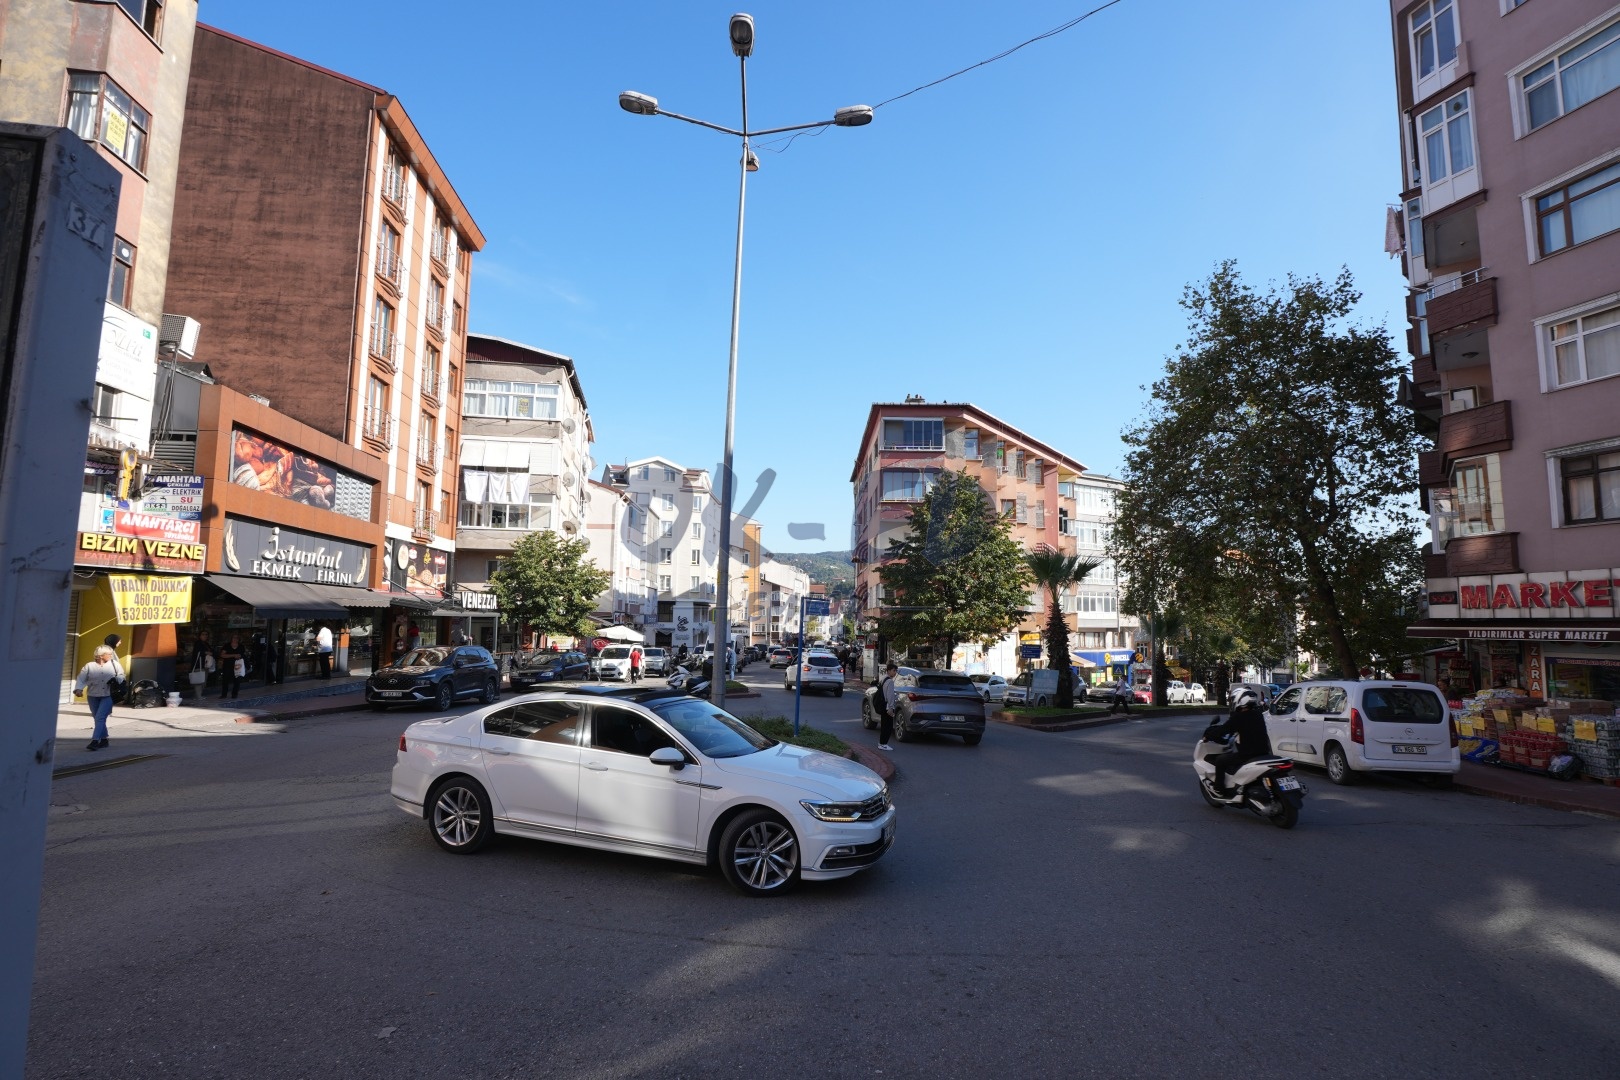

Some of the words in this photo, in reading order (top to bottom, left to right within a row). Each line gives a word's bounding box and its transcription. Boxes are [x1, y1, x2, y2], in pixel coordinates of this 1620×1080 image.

[155, 475, 202, 484] ANAHTAR
[172, 488, 202, 496] ELEKTRİK
[180, 496, 193, 504] SU
[171, 504, 200, 512] DOĞALGAZ
[121, 512, 196, 534] ANAHTARCI
[143, 540, 205, 560] VEZNE
[252, 560, 302, 579] EKMEK
[316, 569, 352, 584] FIRINI
[134, 593, 150, 606] 460
[152, 593, 168, 606] m2
[1460, 579, 1620, 609] MARKE
[141, 607, 159, 620] 603
[161, 607, 174, 619] 22
[175, 607, 187, 619] 67
[1468, 630, 1525, 639] YILDIRIMLAR
[1528, 630, 1560, 640] SÜPER
[1565, 631, 1608, 640] MARKET
